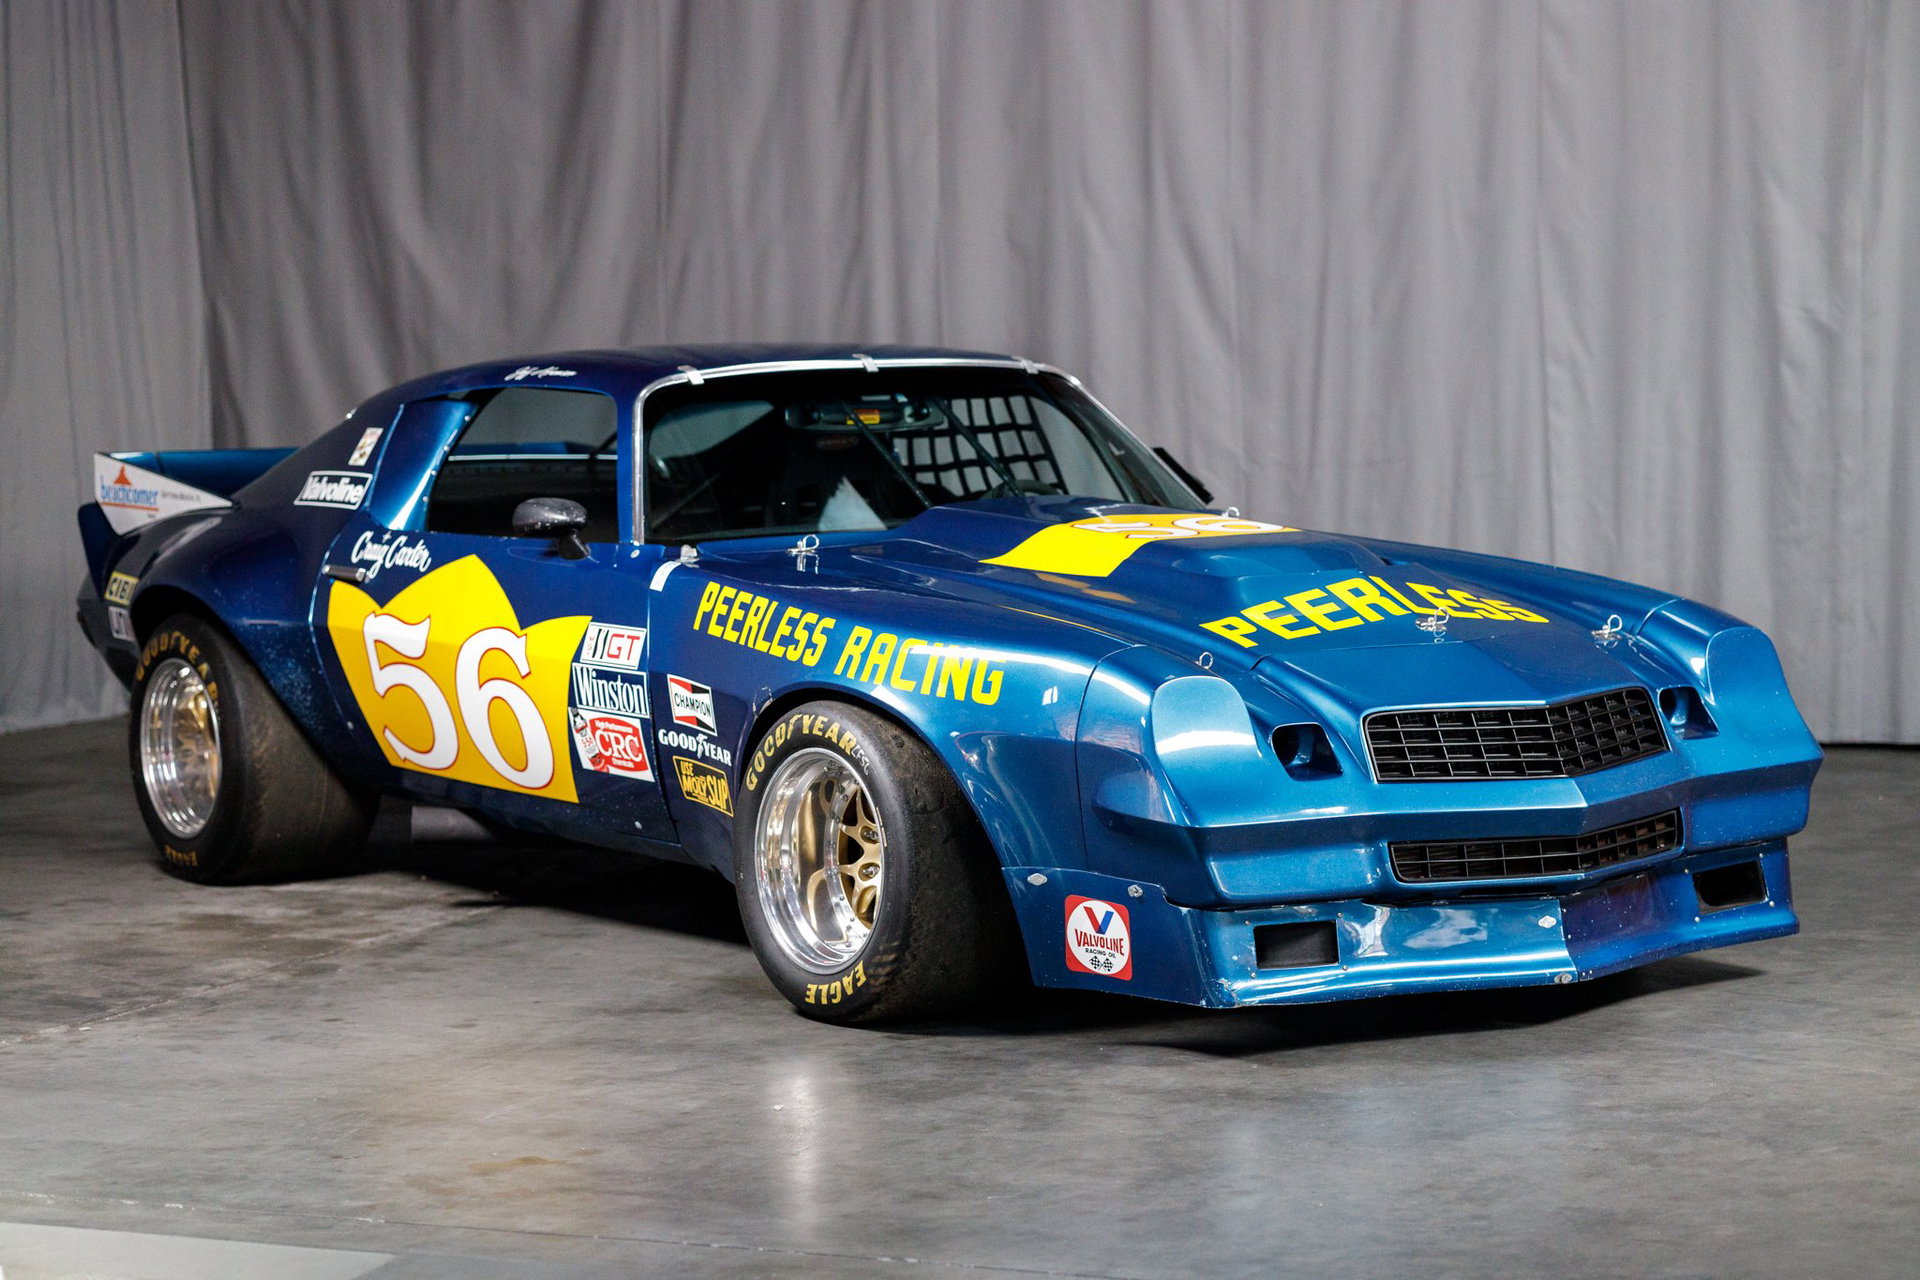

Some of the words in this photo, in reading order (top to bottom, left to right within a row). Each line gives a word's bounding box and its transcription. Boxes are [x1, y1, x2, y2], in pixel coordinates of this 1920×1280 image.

[301, 476, 365, 504] Valvoline
[1072, 516, 1285, 539] 56
[351, 530, 390, 579] Craig
[384, 535, 432, 572] Carter
[1199, 575, 1550, 648] PEERLESS
[693, 580, 837, 668] PEERLESS
[833, 625, 1006, 706] RACING
[363, 611, 555, 790] 56
[575, 666, 649, 716] Winston
[673, 692, 712, 718] CHAMPION
[595, 729, 643, 762] CRC
[658, 728, 732, 767] GOODYEAR
[746, 713, 858, 791] GOODYEAR
[680, 760, 694, 776] USE
[1074, 928, 1125, 957] VALVOLINE
[1085, 947, 1107, 957] RACING
[1108, 951, 1117, 959] OIL
[804, 959, 867, 1005] EAGLE
